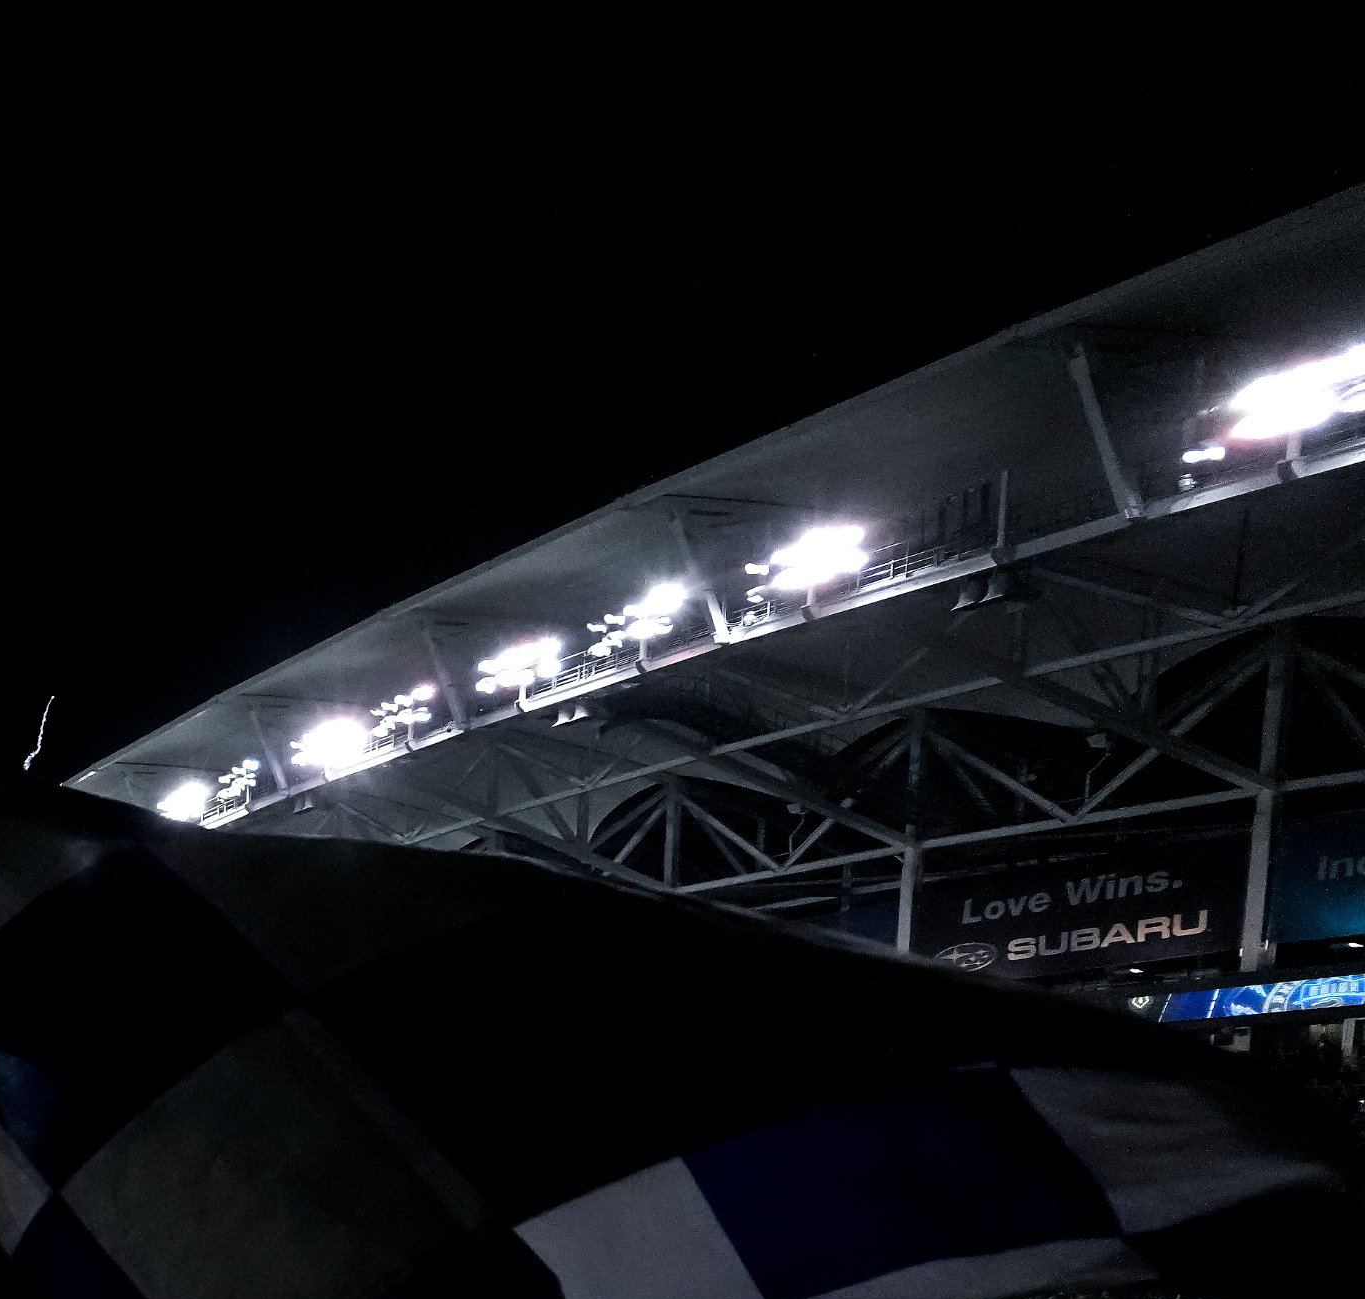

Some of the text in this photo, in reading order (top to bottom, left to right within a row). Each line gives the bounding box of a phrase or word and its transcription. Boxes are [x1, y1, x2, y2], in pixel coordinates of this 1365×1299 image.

[962, 870, 1184, 924] Love Wins.
[1007, 909, 1208, 961] SUBARU
